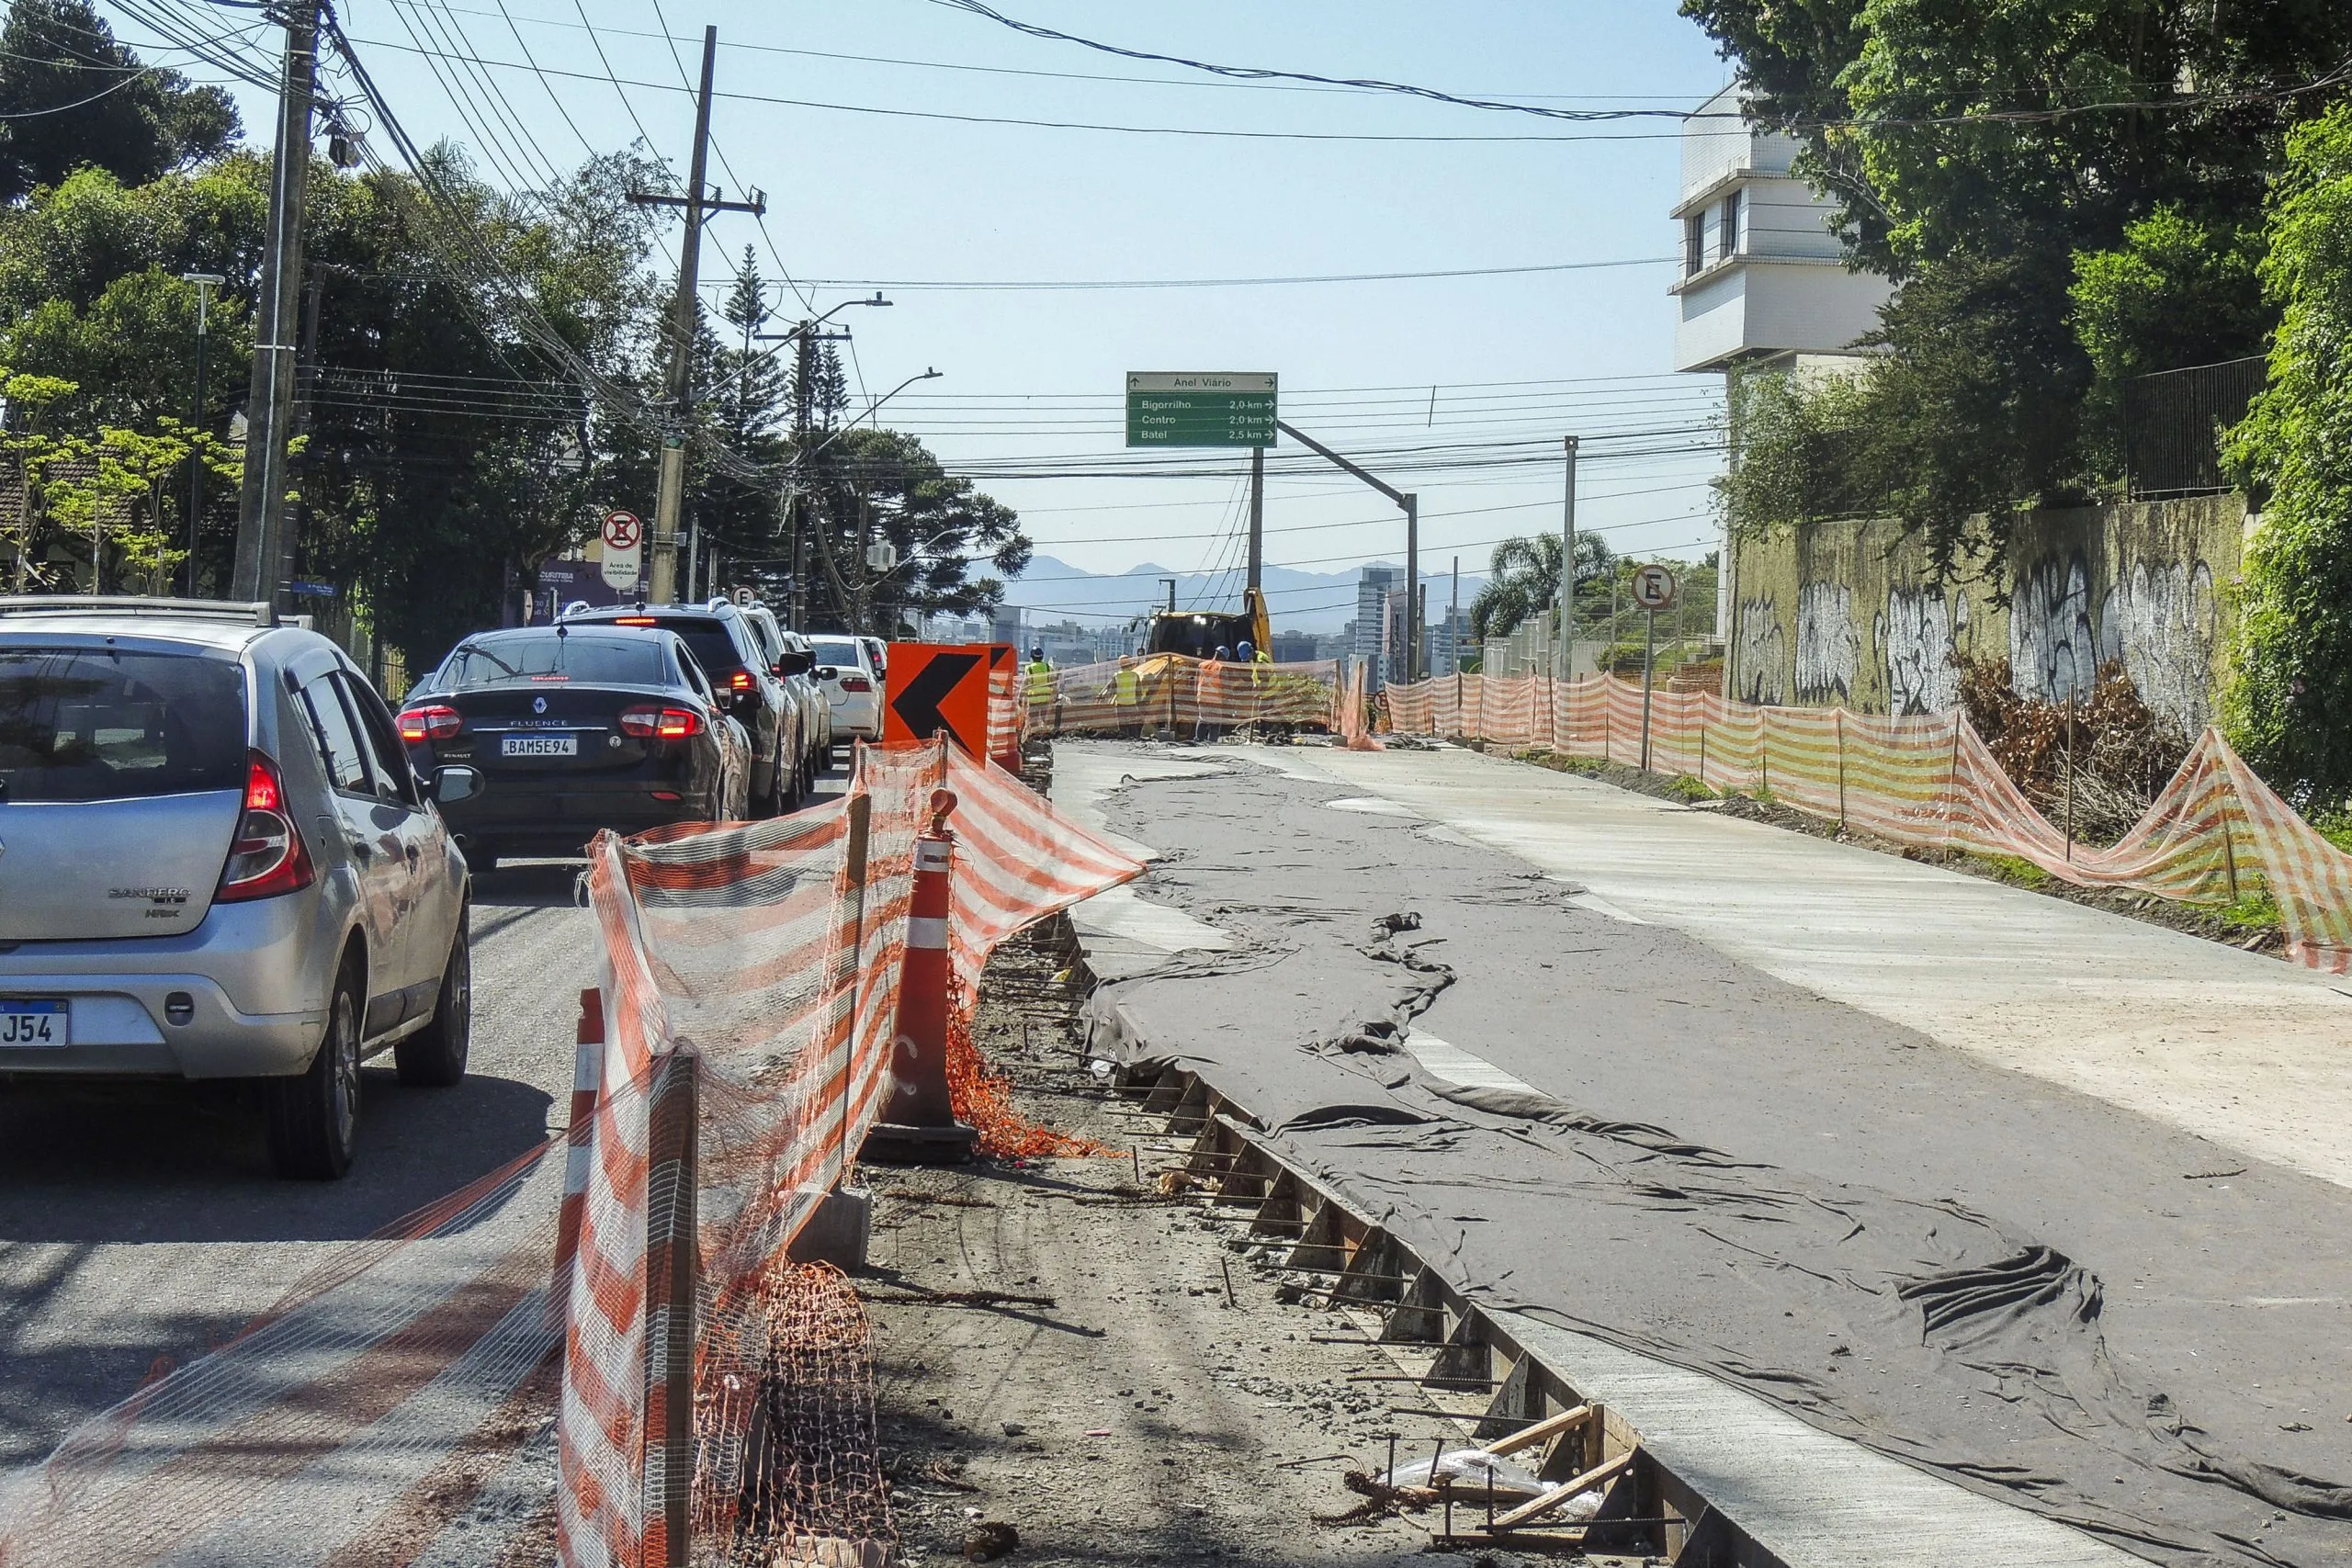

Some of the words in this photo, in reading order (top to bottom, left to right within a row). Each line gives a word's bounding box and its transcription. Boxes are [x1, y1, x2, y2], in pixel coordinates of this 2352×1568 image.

[1174, 378, 1196, 387] Anel
[1203, 378, 1232, 387] Viário
[1141, 400, 1191, 411] Bigorrilho
[1229, 400, 1245, 410] 2,0
[1247, 400, 1262, 409] km
[1141, 415, 1176, 424] Centro
[1229, 415, 1245, 424] 2,0
[1247, 415, 1262, 424] km
[1141, 430, 1168, 439] Batel
[1228, 431, 1244, 440] 2,5
[1247, 430, 1261, 439] km
[739, 591, 749, 604] E
[509, 739, 569, 754] BAM5E94
[108, 886, 191, 897] SANDERO
[2, 1015, 52, 1043] J54
